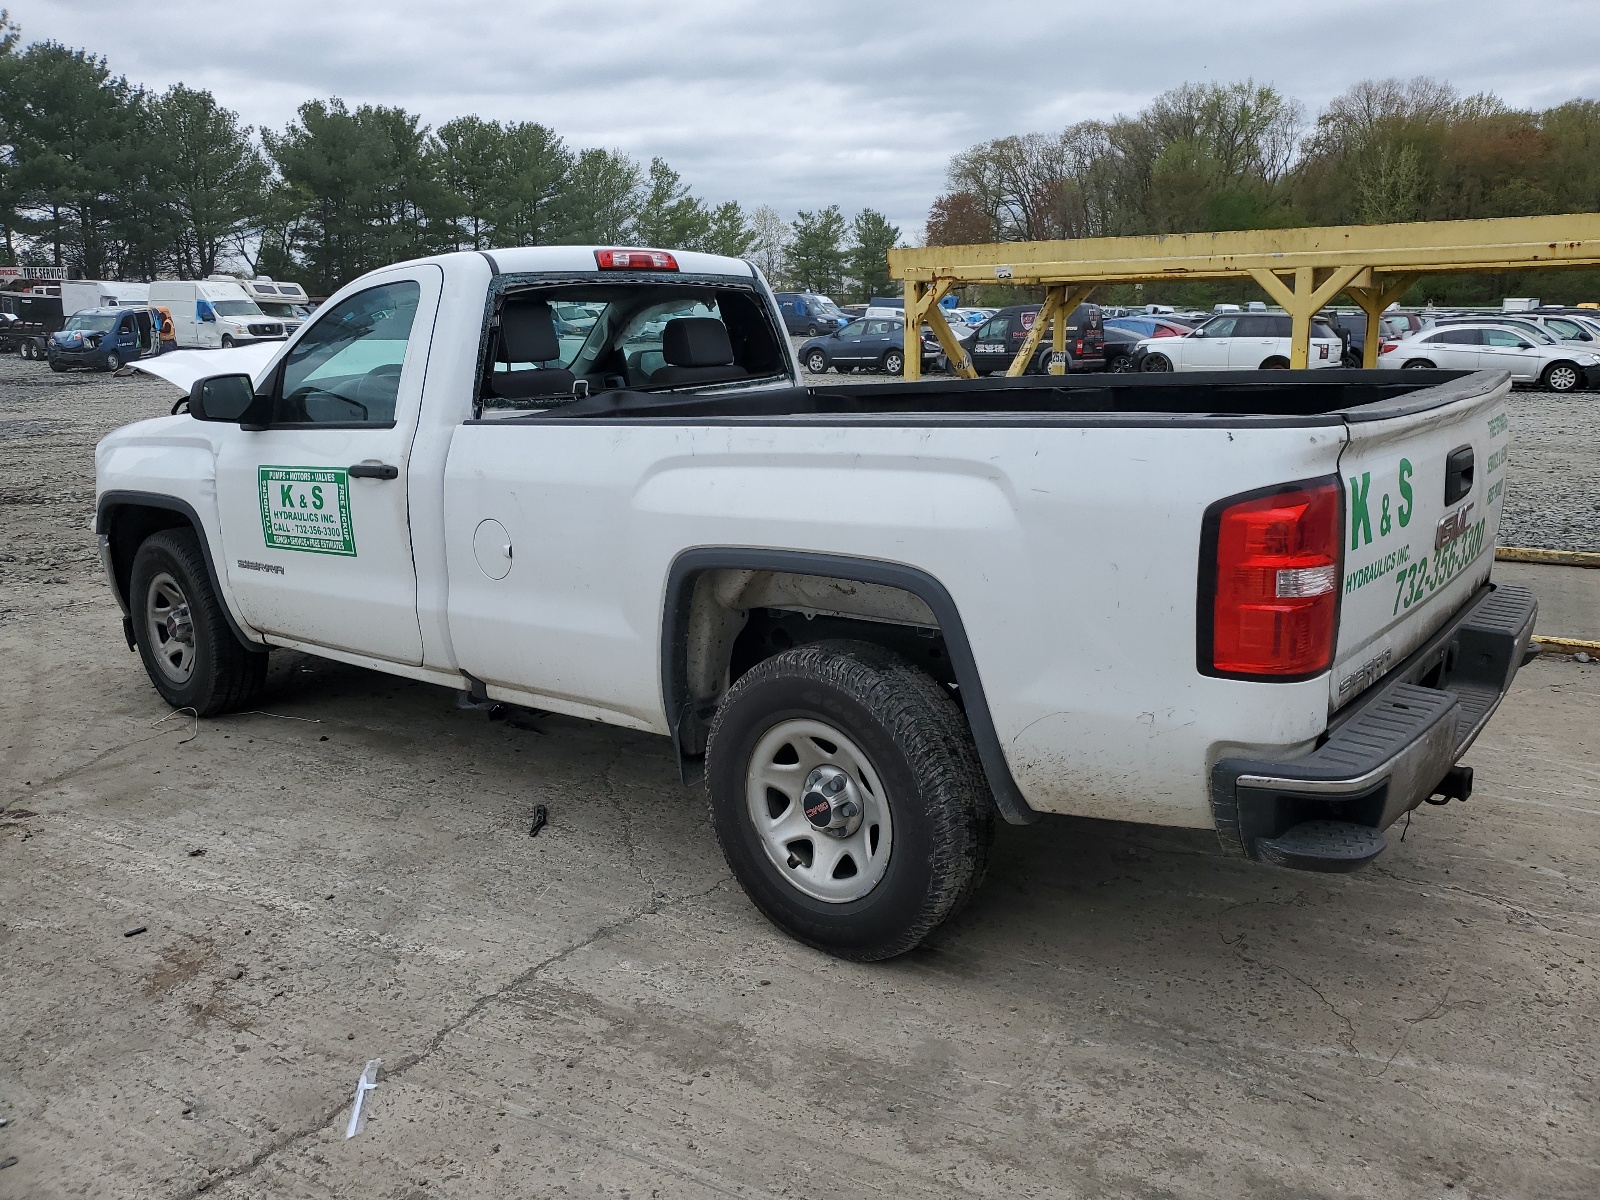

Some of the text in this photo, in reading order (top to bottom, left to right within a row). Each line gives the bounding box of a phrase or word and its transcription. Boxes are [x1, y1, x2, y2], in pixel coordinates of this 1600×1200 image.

[23, 267, 38, 279] TREE
[269, 471, 335, 482] PUMPS MOTORS VALVES
[261, 480, 272, 534] CYLINDERS
[280, 484, 324, 510] K & S
[1349, 471, 1373, 551] K
[1380, 493, 1392, 537] &
[1398, 457, 1413, 528] S
[273, 509, 337, 524] HYDRAULICS INC.
[338, 483, 350, 541] FREE PICKUP
[273, 522, 291, 533] CALL
[294, 524, 341, 537] 732-356-3300
[309, 538, 321, 548] FREE
[321, 540, 345, 550] ESTIMATES
[237, 559, 285, 575] SIERRA
[1345, 543, 1411, 595] HYDRAULICS INC.
[1393, 517, 1486, 617] 732-356-3300
[1339, 646, 1392, 697] SIERRA
